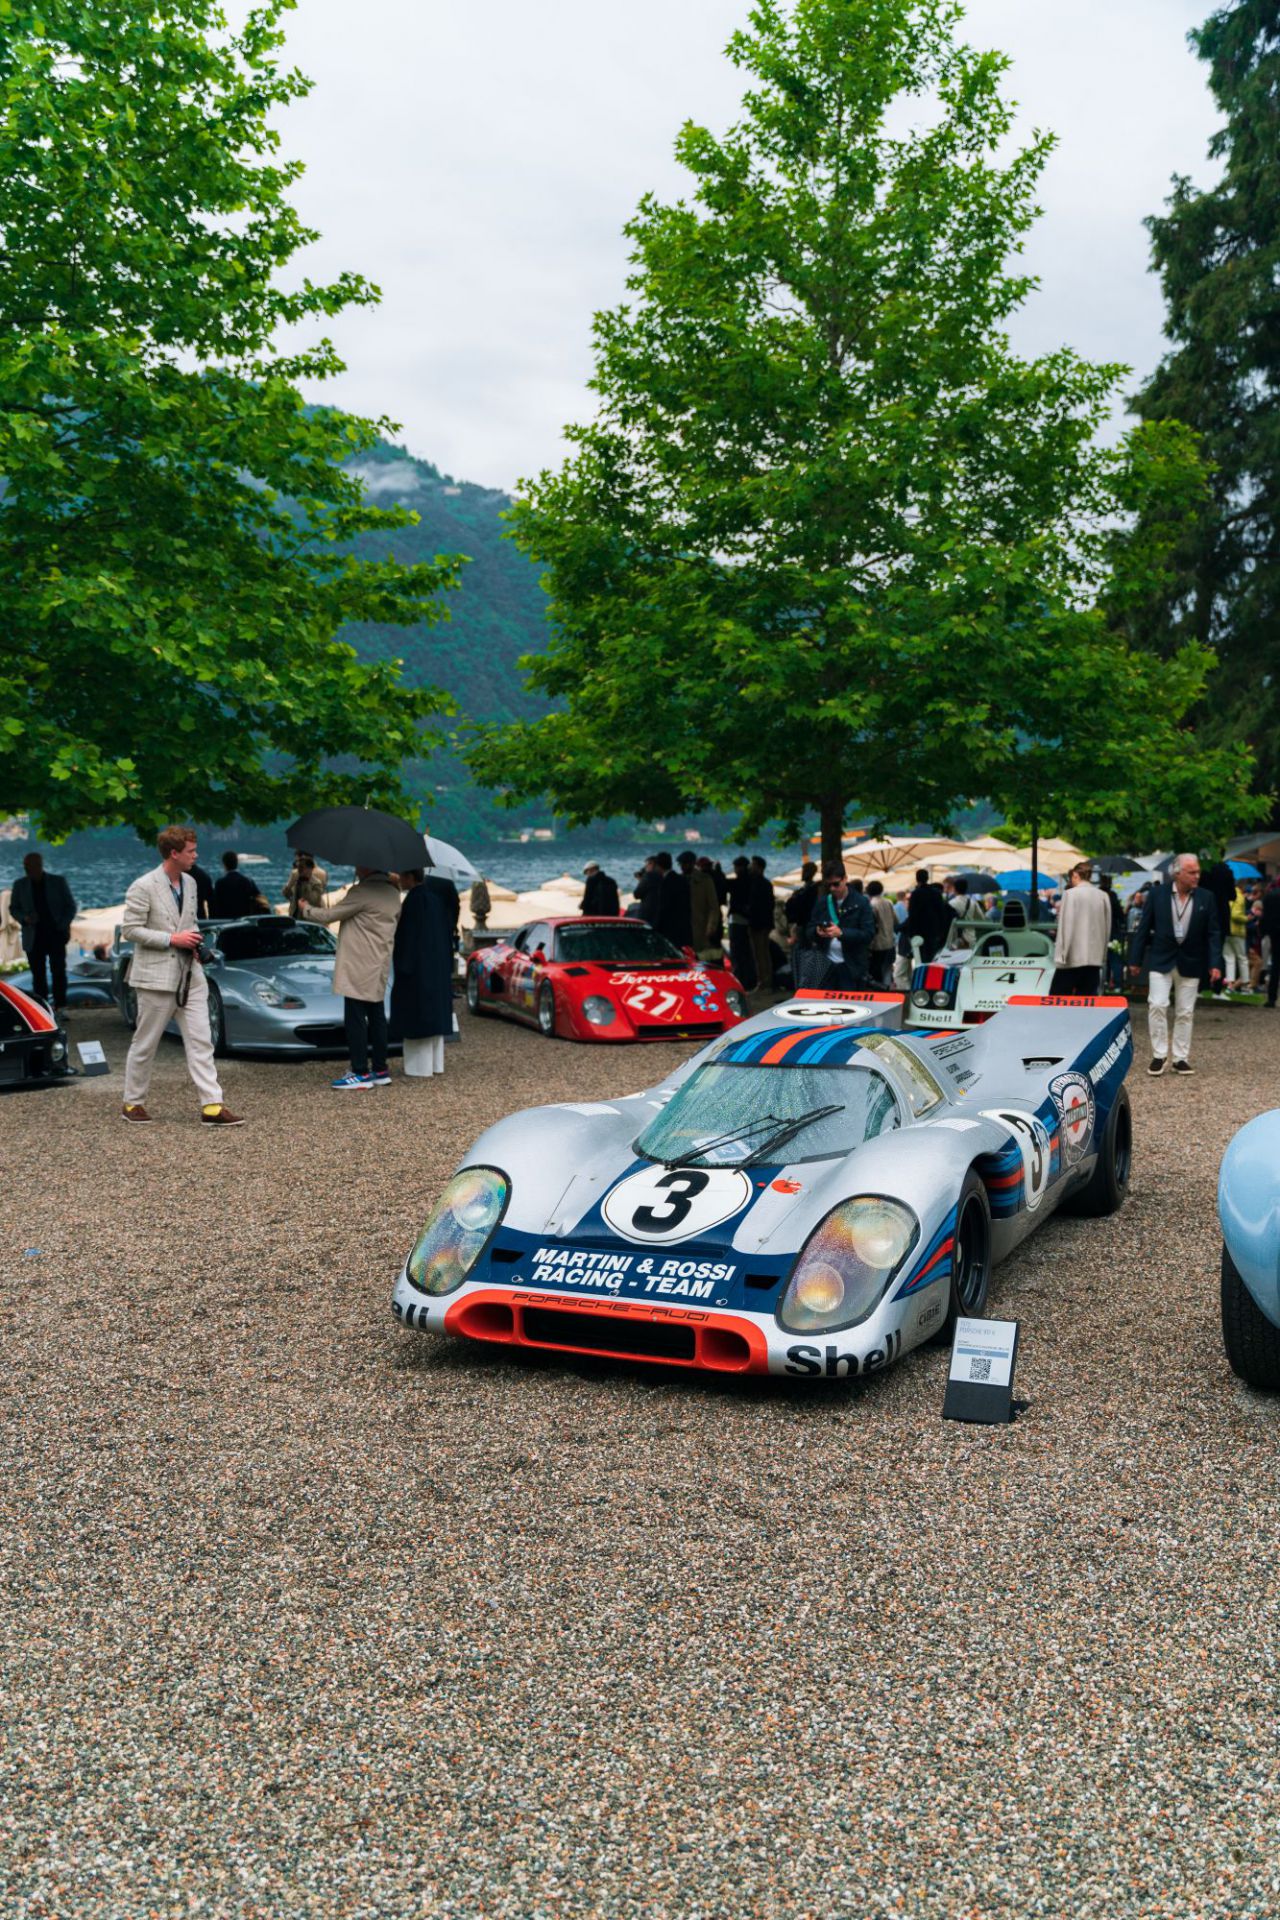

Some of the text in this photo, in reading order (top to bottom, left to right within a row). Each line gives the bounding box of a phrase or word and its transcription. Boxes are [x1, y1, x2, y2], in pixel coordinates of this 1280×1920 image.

[995, 972, 1017, 984] 4
[627, 985, 678, 1017] 27
[824, 992, 874, 1002] Shell
[1040, 997, 1095, 1007] Shell
[919, 1012, 952, 1023] Shell
[999, 1113, 1042, 1193] 3
[632, 1170, 710, 1234] 3
[532, 1248, 736, 1281] MARTINI & ROSSI
[531, 1265, 624, 1289] RACING
[644, 1276, 715, 1298] TEAM
[784, 1328, 901, 1376] Shell
